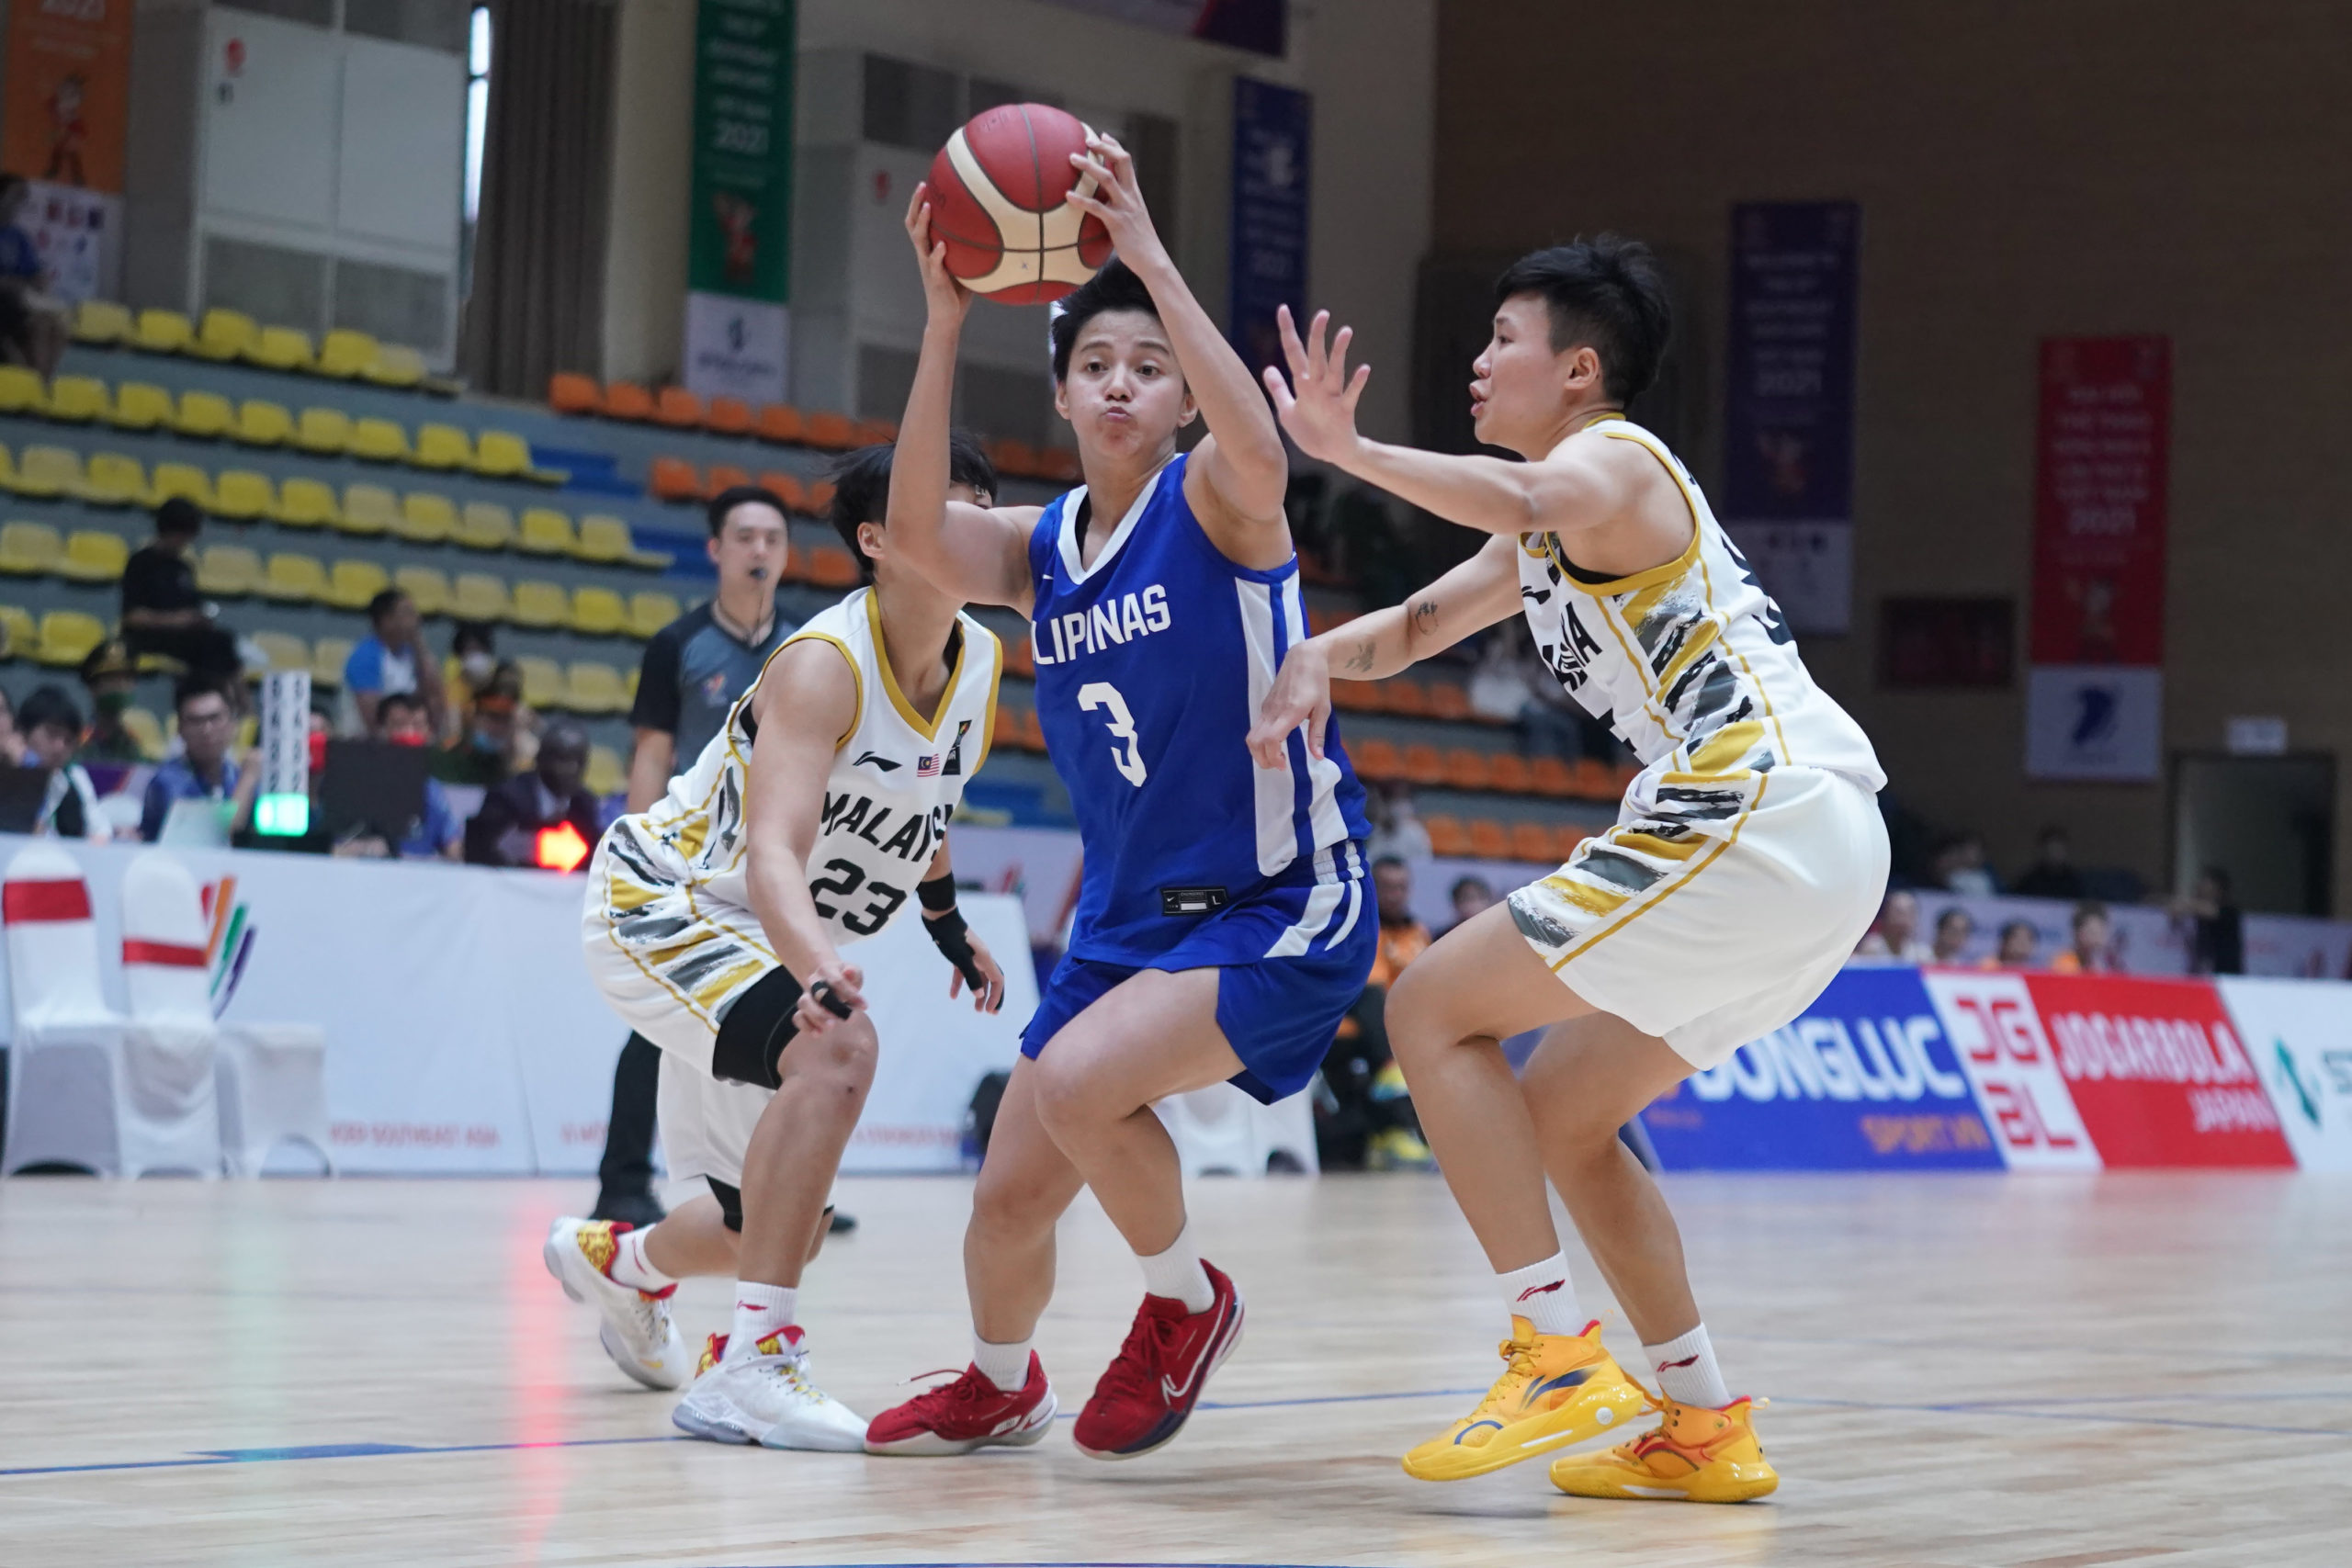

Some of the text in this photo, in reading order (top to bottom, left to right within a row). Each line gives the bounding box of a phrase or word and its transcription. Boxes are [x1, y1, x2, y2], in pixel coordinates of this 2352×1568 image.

[1031, 584, 1171, 664] LIPINAS
[1077, 682, 1148, 788] 3
[809, 857, 908, 936] 23
[2051, 1012, 2257, 1084] JOGARBOLA
